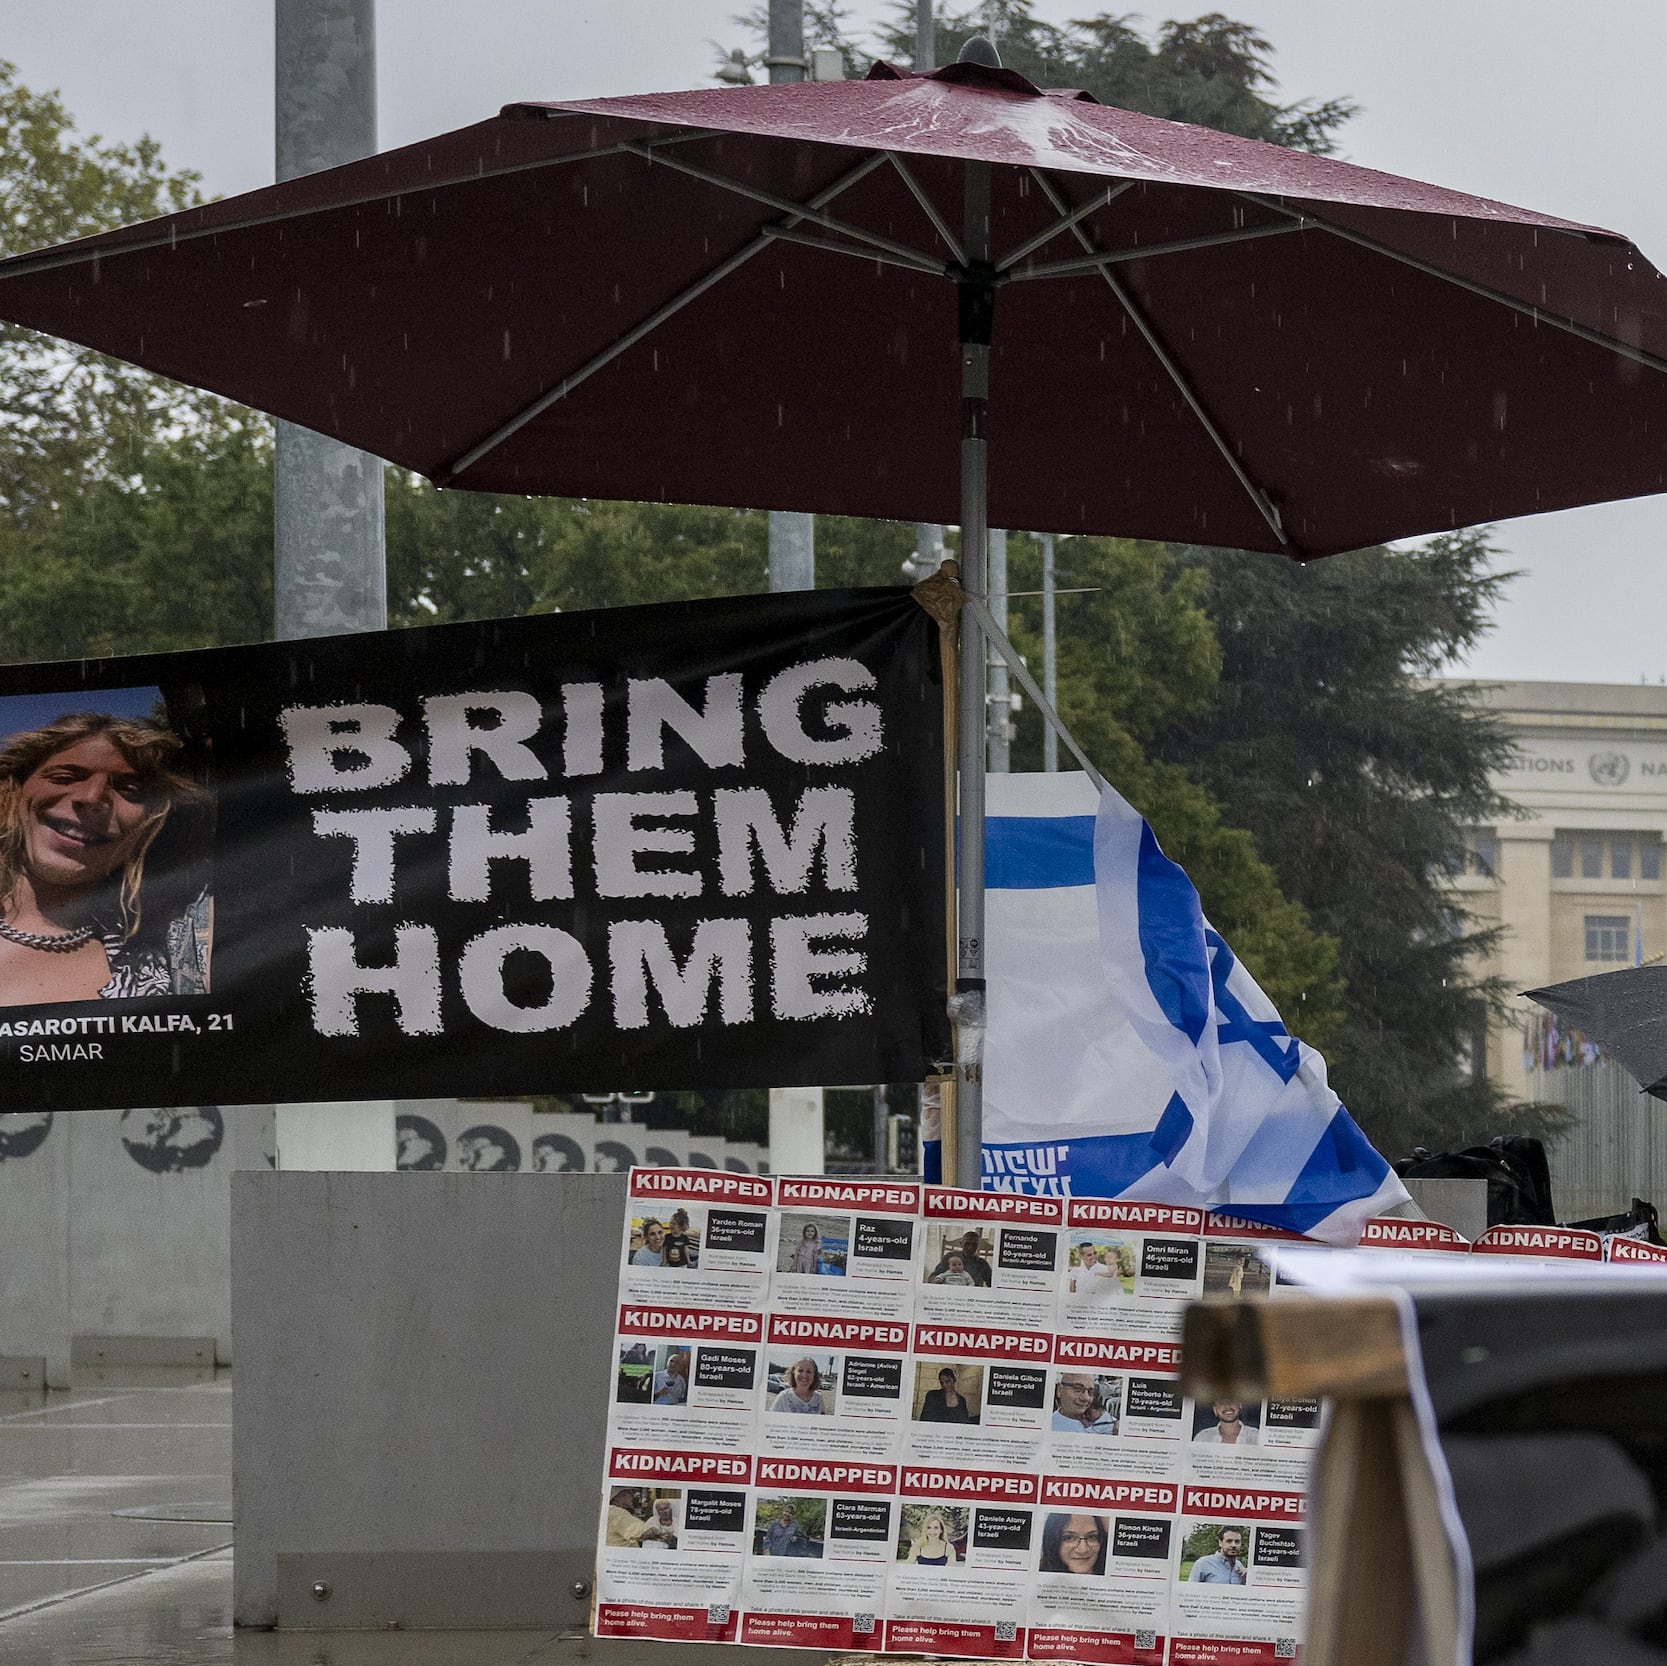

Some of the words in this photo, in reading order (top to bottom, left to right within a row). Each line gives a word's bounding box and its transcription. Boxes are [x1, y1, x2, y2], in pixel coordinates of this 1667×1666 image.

[279, 655, 883, 794] BRING
[1505, 757, 1575, 774] ATIONS
[312, 784, 858, 904] THEM
[302, 911, 874, 1036] HOME
[122, 1014, 201, 1035] KALFA,
[207, 1013, 234, 1031] 21
[19, 1043, 104, 1062] SAMAR
[636, 1174, 768, 1197] KIDNAPPED
[783, 1184, 915, 1205] KIDNAPPED
[929, 1194, 1058, 1216] KIDNAPPED
[1072, 1204, 1200, 1225] KIDNAPPED
[711, 1217, 737, 1227] Yarden
[738, 1219, 763, 1229] Roman
[859, 1224, 876, 1233] Raz
[710, 1234, 733, 1242] Israeli
[858, 1234, 908, 1245] 4-years-old
[1003, 1233, 1038, 1243] Fernando
[1361, 1224, 1464, 1243] IDNAPPE
[858, 1243, 884, 1253] Israeli
[1477, 1232, 1598, 1252] KIDNAPPED
[1002, 1249, 1047, 1259] 60-years-old
[1146, 1245, 1165, 1254] Omri
[1167, 1246, 1189, 1255] Miran
[1145, 1253, 1193, 1264] 46-years-old
[1145, 1262, 1169, 1272] Israeli
[625, 1311, 758, 1334] KIDNAPPED
[773, 1320, 904, 1343] KIDNAPPED
[919, 1330, 1048, 1353] KIDNAPPED
[700, 1354, 720, 1363] Gadi
[720, 1355, 747, 1364] Moses
[1060, 1341, 1182, 1364] KIDNAPPED
[700, 1363, 751, 1374] 80-years-old
[699, 1372, 723, 1381] Israeli
[993, 1372, 1019, 1381] Daniela
[1020, 1373, 1043, 1383] Gilboa
[991, 1388, 1013, 1397] Israeli
[1269, 1412, 1294, 1421] Israeli
[615, 1454, 748, 1476] KIDNAPPED
[760, 1463, 893, 1485] KIDNAPPED
[905, 1472, 1034, 1495] KIDNAPPED
[1046, 1481, 1174, 1505] KIDNAPPED
[690, 1498, 718, 1508] Margalit
[719, 1499, 742, 1508] Moses
[836, 1503, 855, 1512] Clara
[856, 1505, 887, 1513] Marman
[1186, 1491, 1307, 1513] KIDNAPPED
[836, 1511, 881, 1521] 63-years-old
[978, 1514, 1004, 1523] Daniele
[1005, 1516, 1027, 1525] Alony
[604, 1609, 629, 1619] Please
[631, 1610, 649, 1621] help
[650, 1612, 671, 1623] bring
[673, 1612, 694, 1622] them
[604, 1618, 625, 1627] home
[626, 1619, 648, 1628] alive.
[892, 1625, 919, 1635] Please
[920, 1627, 938, 1637] help
[939, 1628, 960, 1638] bring
[961, 1629, 981, 1638] them
[892, 1634, 913, 1642] home
[915, 1635, 936, 1644] alive.
[1175, 1642, 1201, 1651] Please
[1202, 1645, 1219, 1653] help
[1220, 1646, 1241, 1654] bring
[1242, 1647, 1262, 1655] them
[1197, 1653, 1217, 1661] alive.
